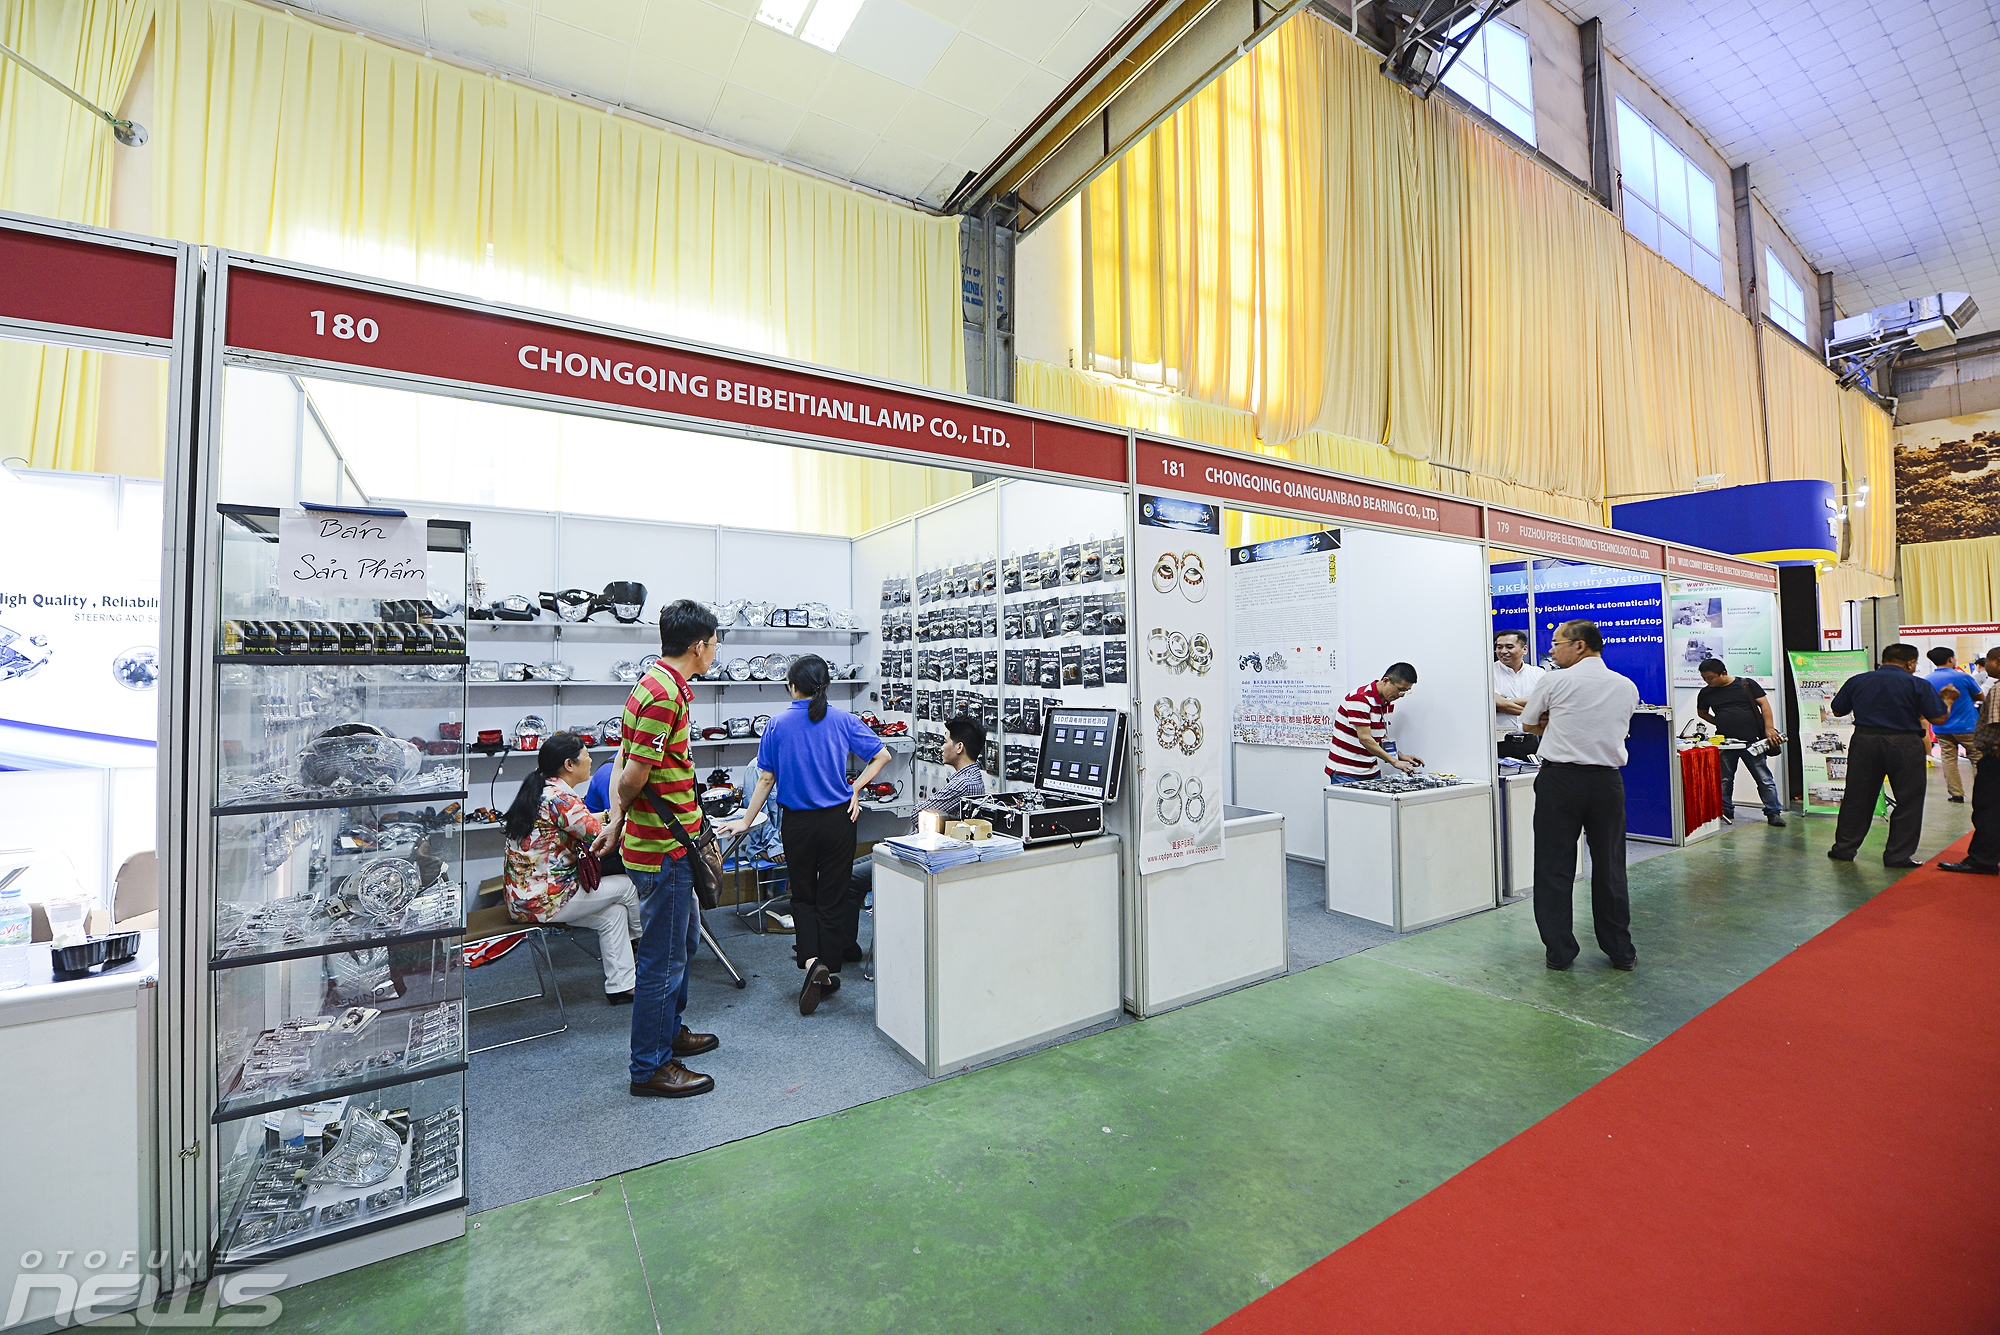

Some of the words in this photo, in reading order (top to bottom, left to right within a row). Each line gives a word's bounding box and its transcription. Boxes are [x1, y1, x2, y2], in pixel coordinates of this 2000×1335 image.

[309, 310, 379, 343] 180
[518, 345, 708, 398] CHONGQING
[716, 379, 925, 433] BEIBEITIANLILAMP
[929, 417, 968, 444] CO.,
[972, 424, 1011, 448] LTD.
[1161, 459, 1185, 478] 181
[1205, 467, 1281, 495] CHONGQING
[1283, 482, 1361, 509] QIANGUANBAO
[1363, 495, 1403, 516] BEARING
[1404, 503, 1421, 518] CO.,
[1422, 506, 1439, 522] LTD.
[320, 519, 386, 539] Bán
[1497, 521, 1510, 533] 179
[1519, 525, 1546, 541] FUZHOU
[1546, 530, 1561, 544] PEPE
[1562, 533, 1598, 550] ELECTRONICS
[1598, 541, 1630, 557] TECHNOLOGY
[1640, 549, 1650, 560] LTD.
[294, 554, 348, 580] Sản
[358, 558, 425, 580] Phẩm
[1498, 583, 1520, 593] PKE
[1572, 578, 1602, 588] entry
[1605, 574, 1651, 586] system
[33, 594, 87, 609] Quality
[1500, 605, 1544, 615] Proximty
[1545, 603, 1595, 613] lock/unlock
[1597, 598, 1661, 609] automatically
[74, 613, 122, 622] STEERING
[125, 614, 145, 622] AND
[1615, 618, 1663, 626] start/stop
[1602, 637, 1627, 645] yless
[1628, 635, 1663, 643] driving
[1245, 714, 1256, 722] 出口
[652, 732, 667, 753] 4
